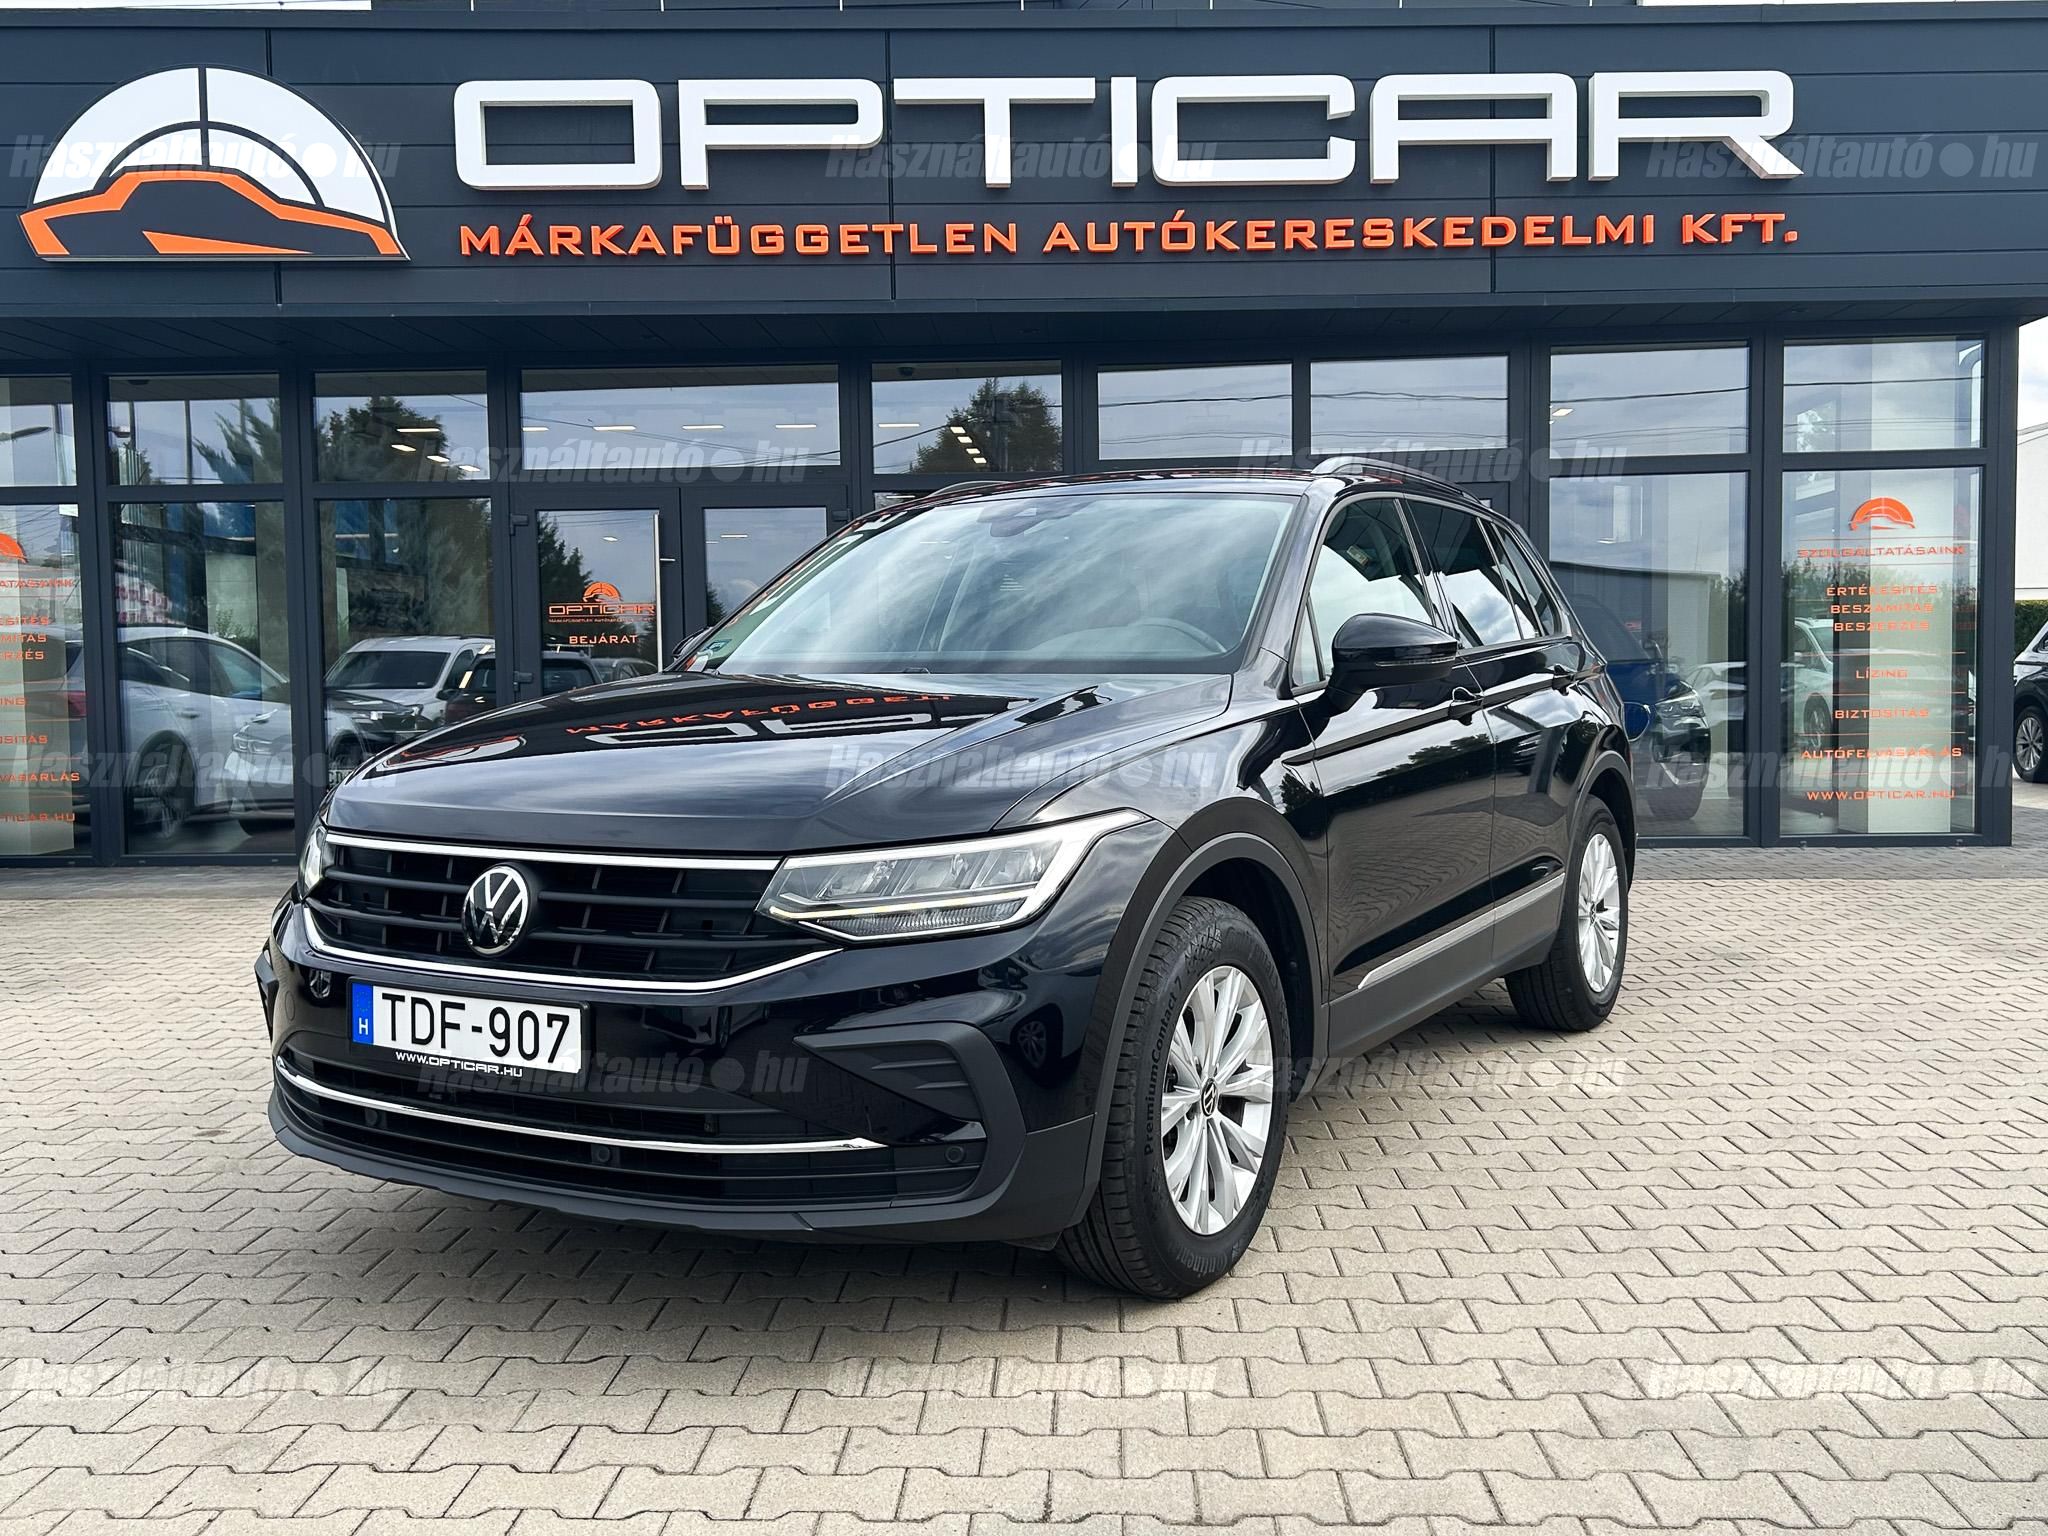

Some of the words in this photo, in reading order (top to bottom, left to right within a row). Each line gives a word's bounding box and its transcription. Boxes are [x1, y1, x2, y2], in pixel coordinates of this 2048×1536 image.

[453, 70, 1803, 191] OPTICAR
[460, 214, 1018, 257] MÁRKAFÜGGETLEN
[1043, 209, 1655, 253] AUTÓKERESKEDELMI
[1682, 212, 1798, 246] KFT.
[549, 605, 656, 616] OPTICAR
[569, 633, 639, 645] BEJÁRAT
[358, 1017, 369, 1036] H
[382, 992, 570, 1064] TDF-907
[395, 1050, 524, 1078] WWW.OPTICAR.HU
[1143, 991, 1179, 1157] PremiumContact
